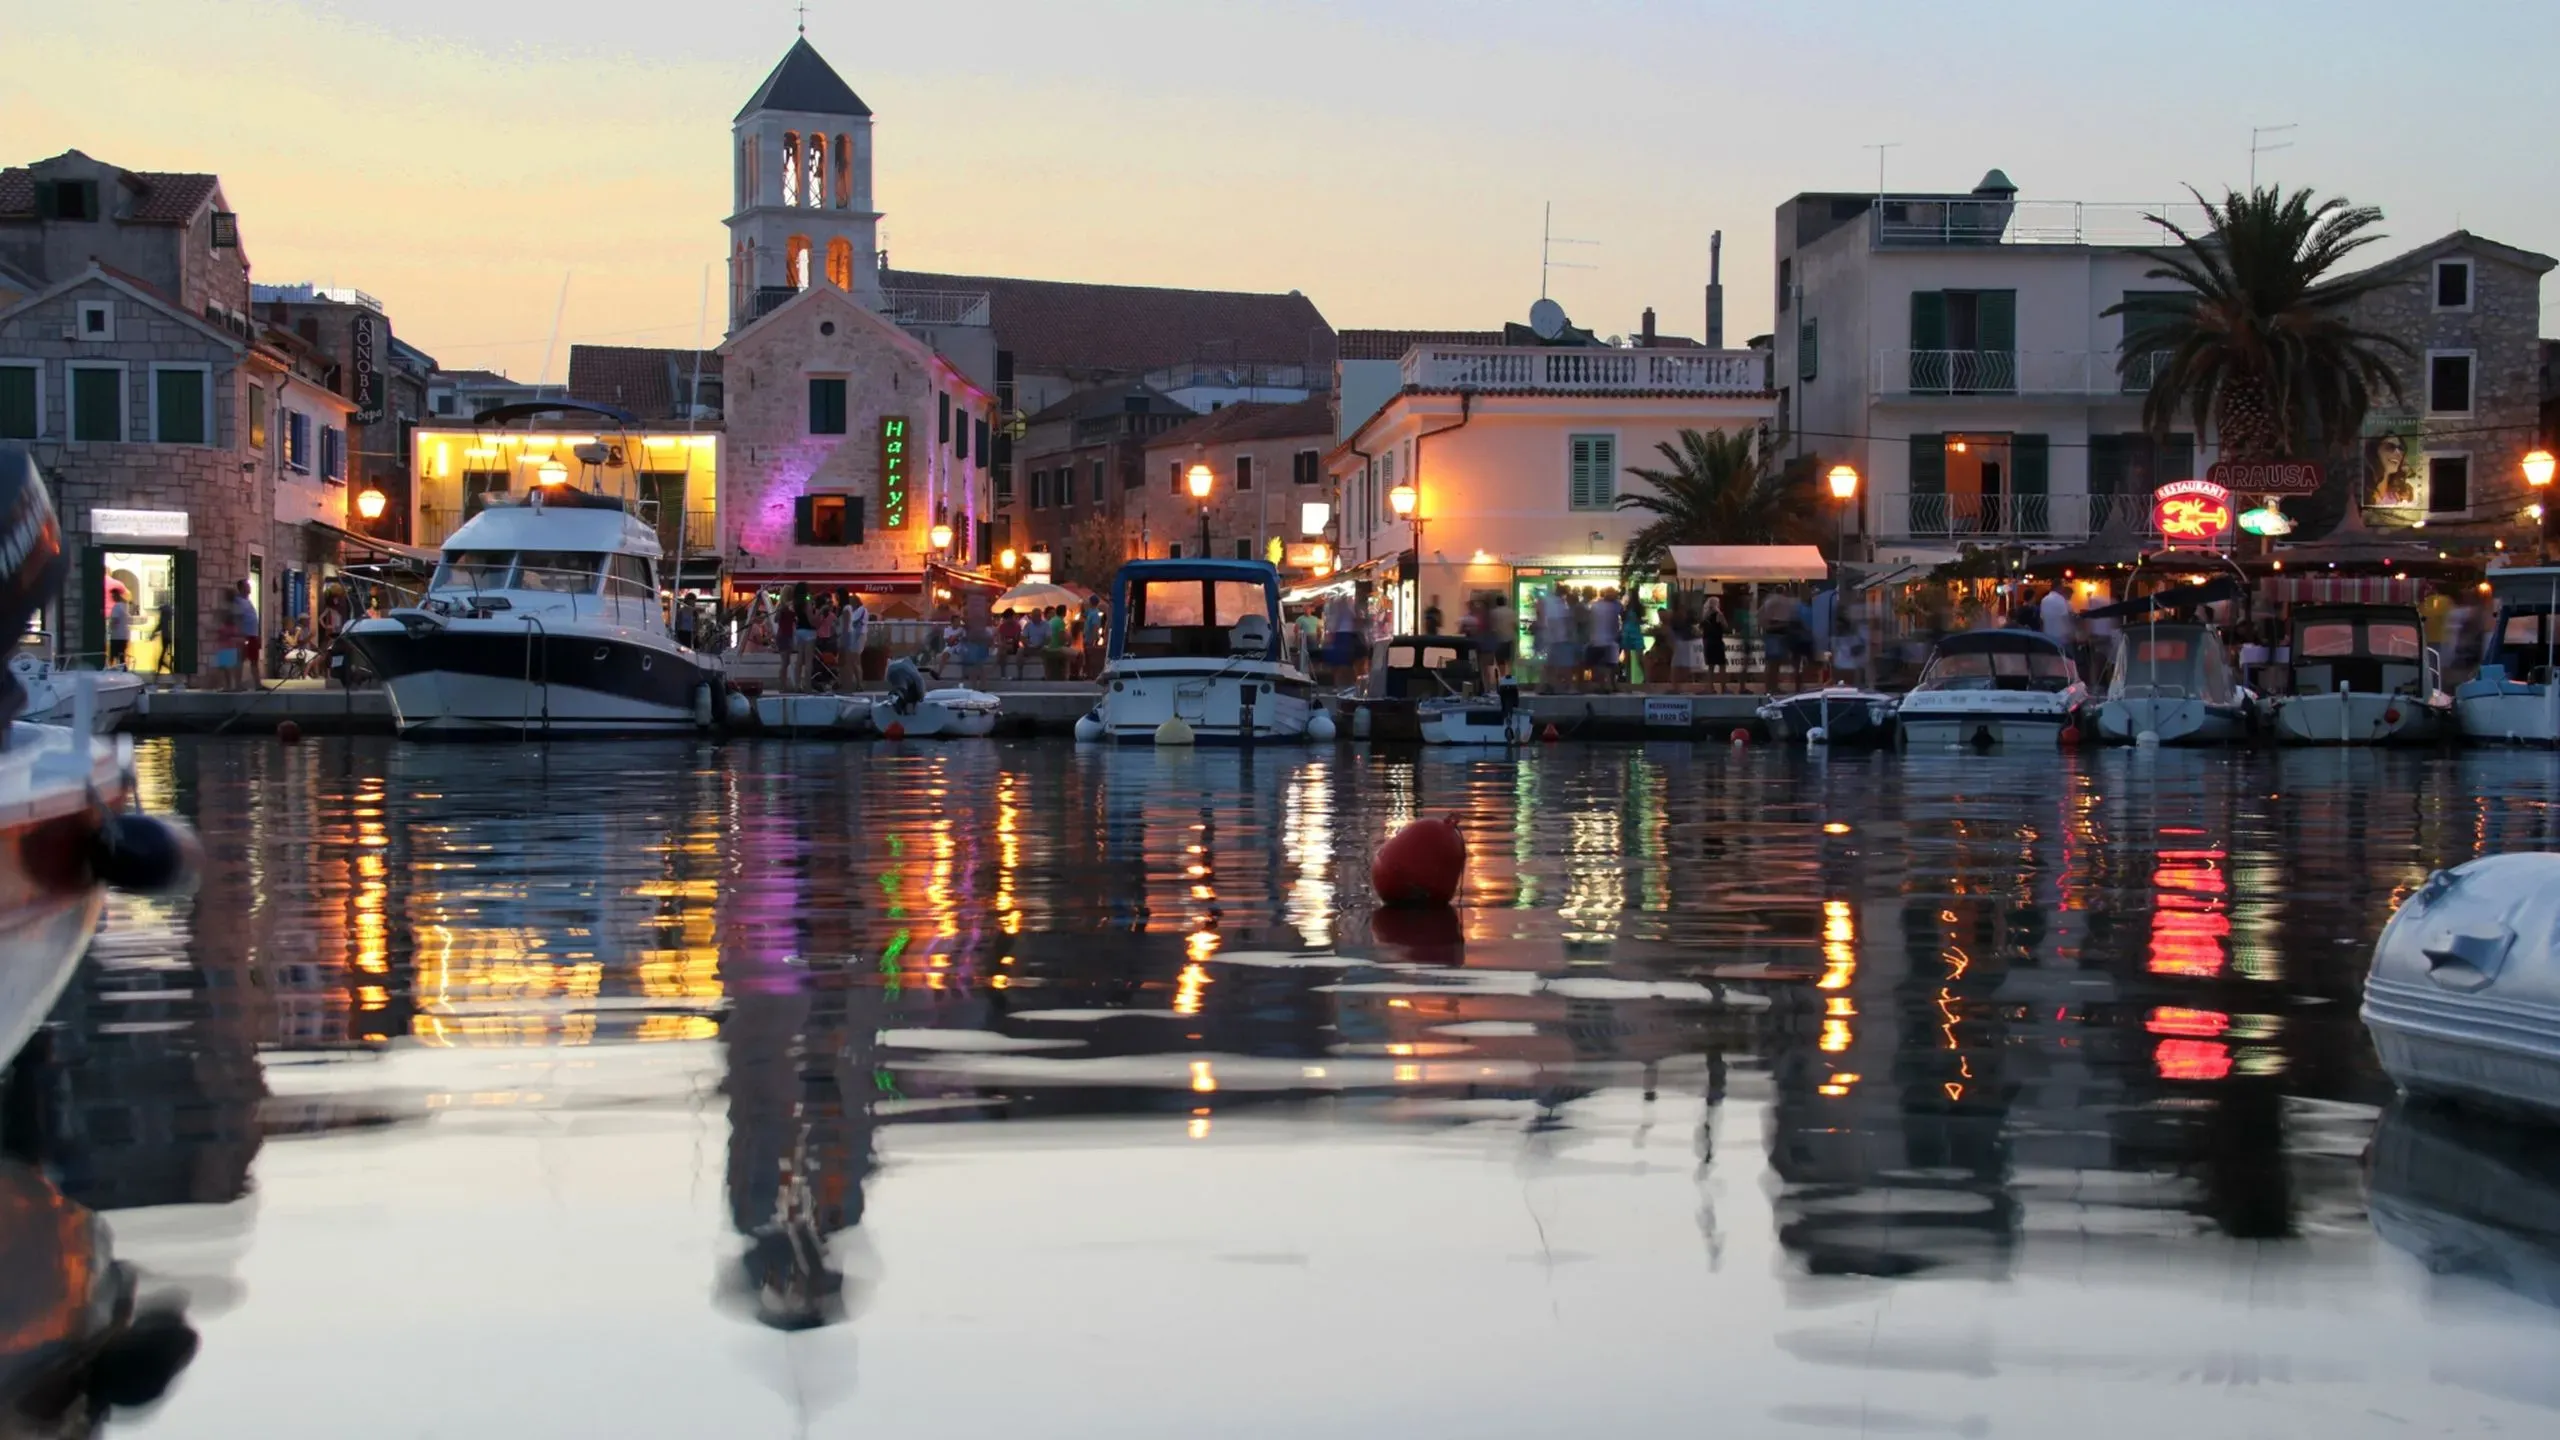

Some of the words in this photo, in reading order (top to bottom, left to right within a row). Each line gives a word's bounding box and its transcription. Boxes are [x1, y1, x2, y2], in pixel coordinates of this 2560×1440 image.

[357, 319, 372, 401] KONOBA
[885, 420, 904, 527] Harry's
[2213, 464, 2320, 488] ARAUSA
[2158, 481, 2227, 500] RESTAURANT
[864, 583, 894, 593] Harry's
